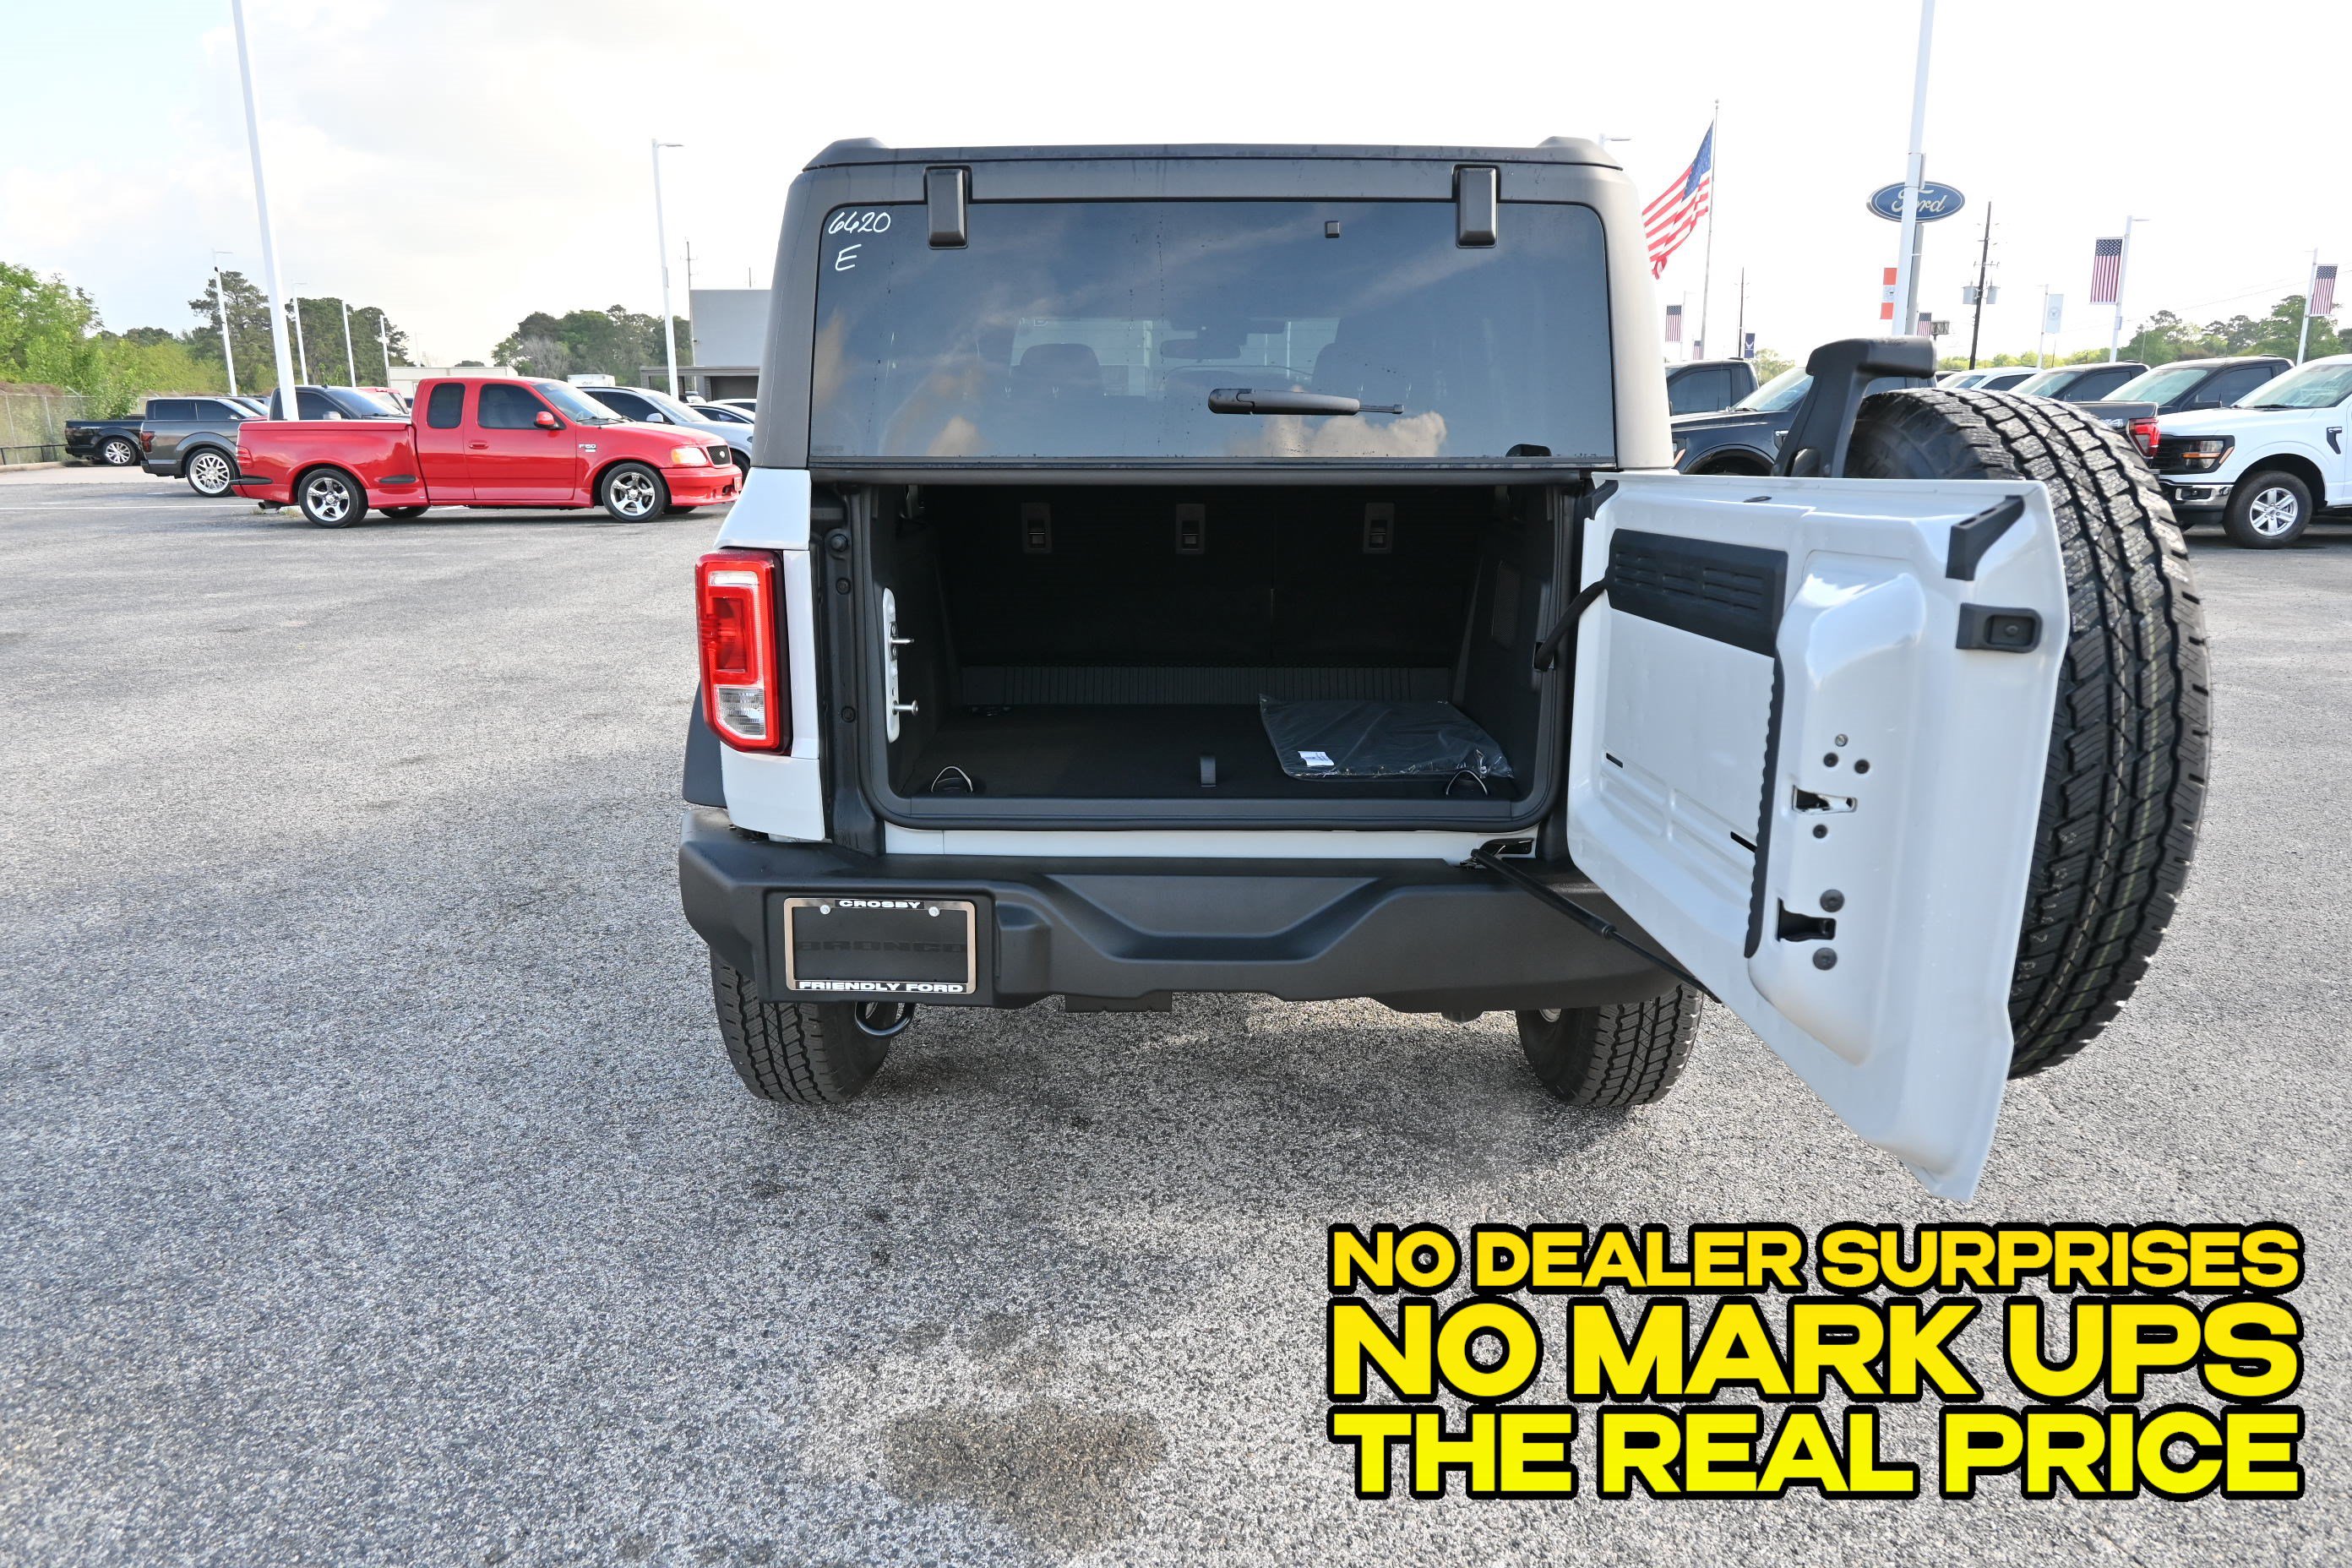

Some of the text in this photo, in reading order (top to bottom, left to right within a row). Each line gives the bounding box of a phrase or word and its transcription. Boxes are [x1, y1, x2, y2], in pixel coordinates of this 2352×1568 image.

[1891, 187, 1947, 213] Frd
[835, 243, 862, 271] E
[838, 899, 921, 910] CROSBY
[798, 981, 964, 994] FRIENDLY FORD
